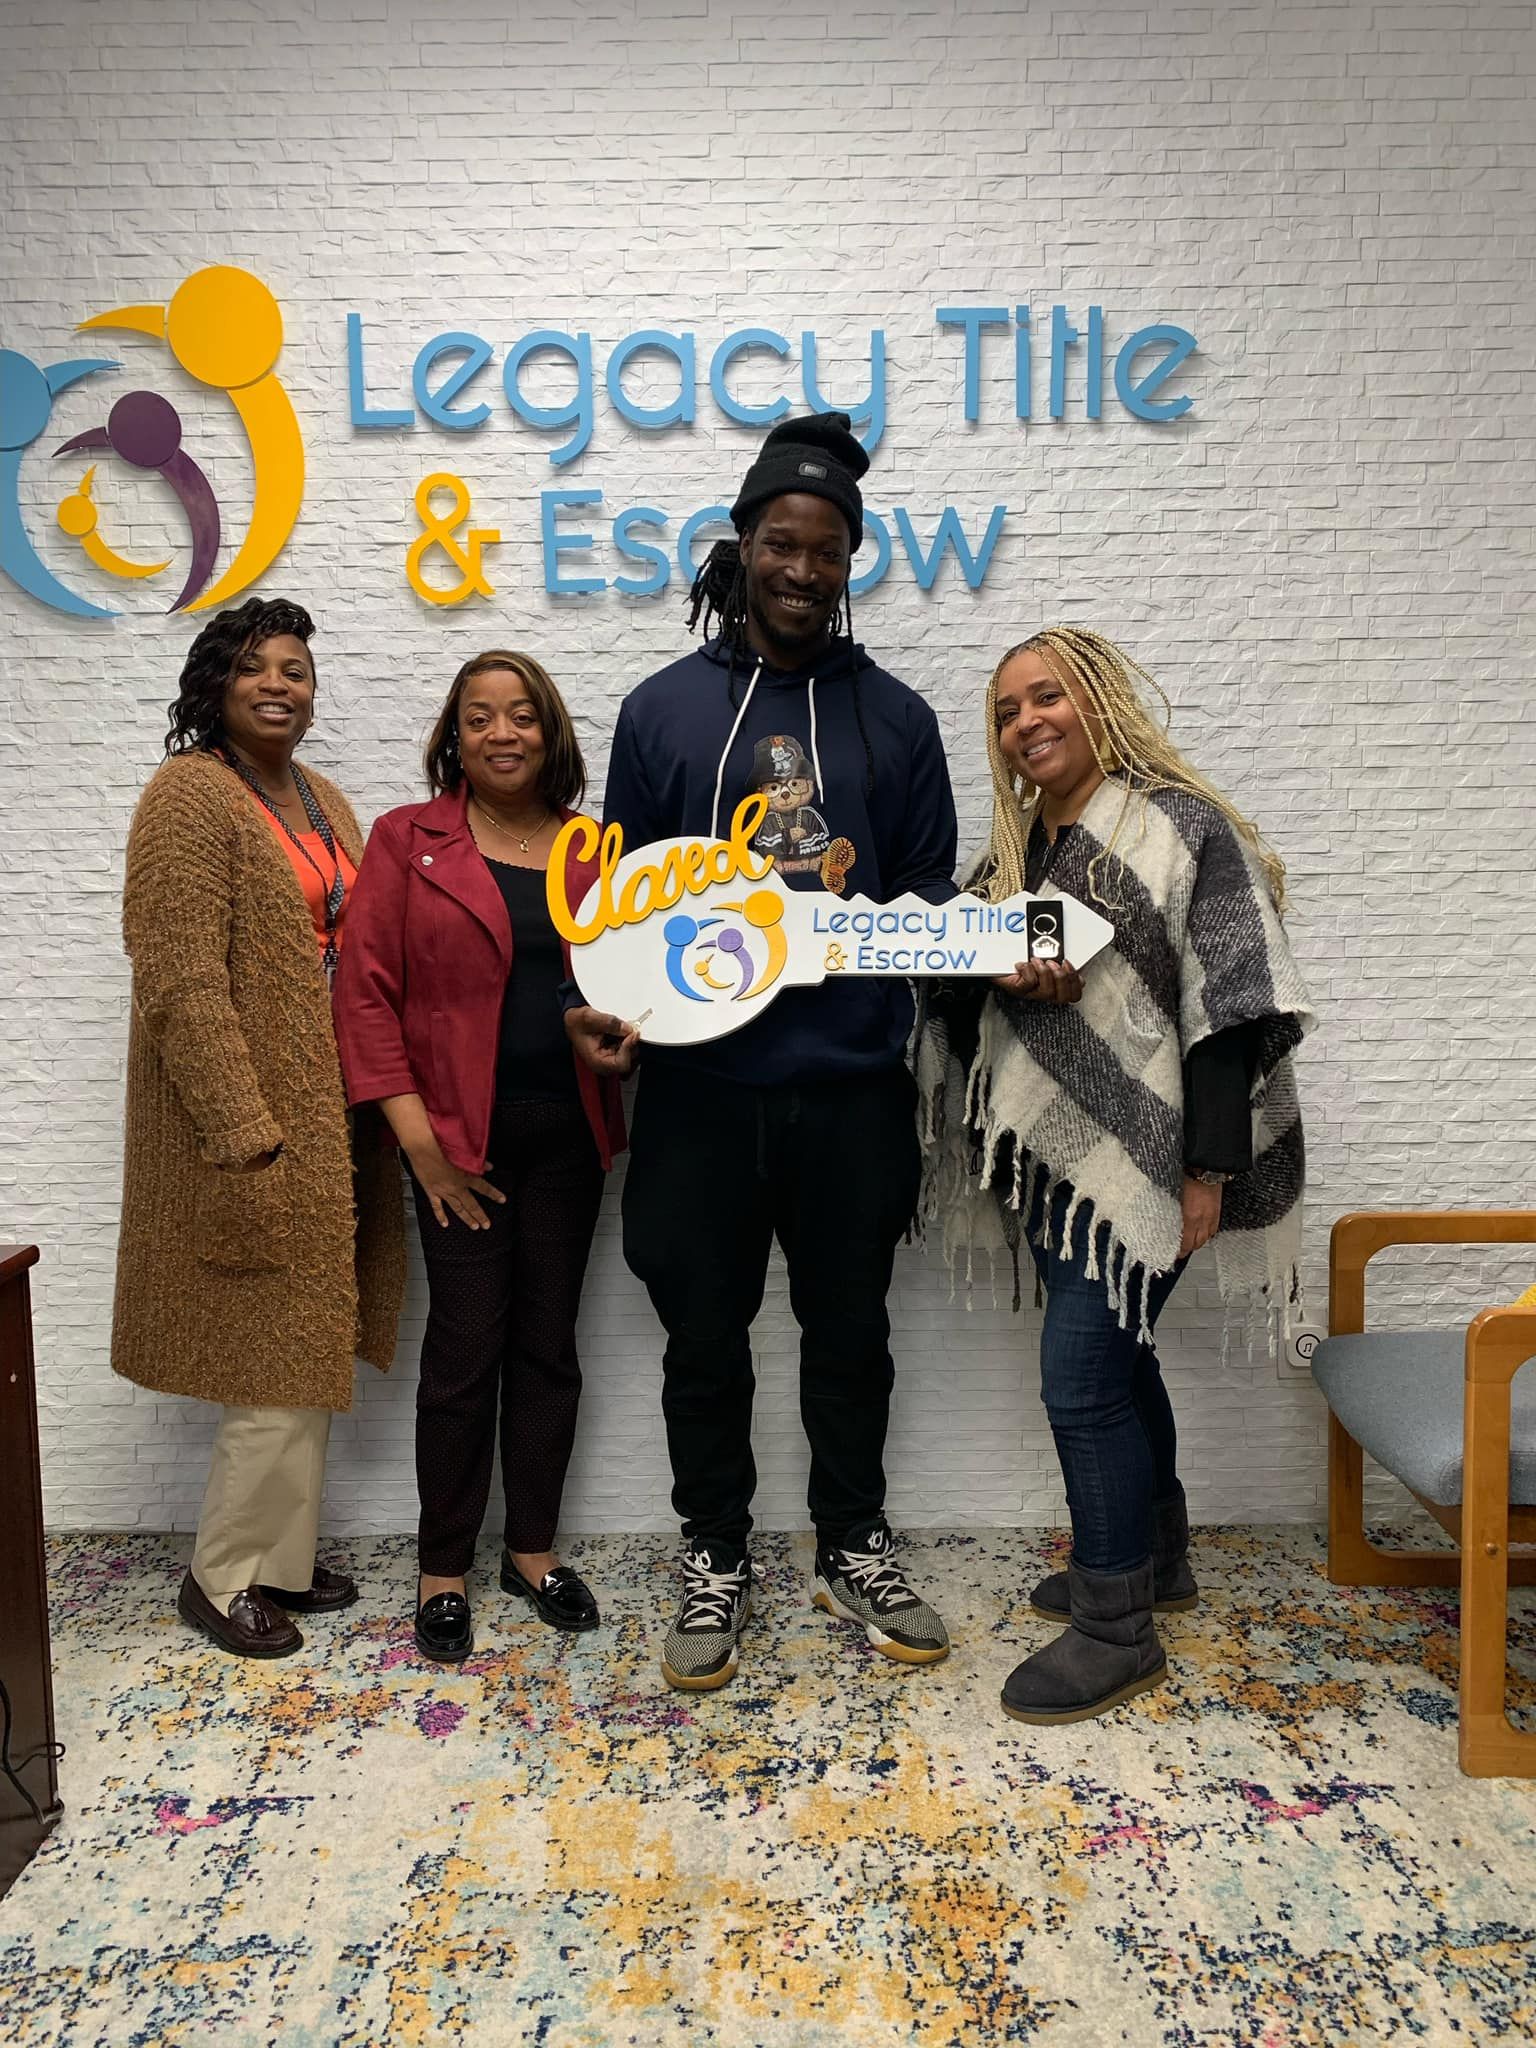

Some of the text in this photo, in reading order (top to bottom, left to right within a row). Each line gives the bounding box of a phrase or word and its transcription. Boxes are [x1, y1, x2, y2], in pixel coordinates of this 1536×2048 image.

[347, 304, 1198, 466] Legacy Title
[405, 472, 1008, 607] & Escw
[545, 792, 775, 946] Closed
[813, 906, 1026, 942] Legacy Title
[824, 941, 978, 972] & Escrow
